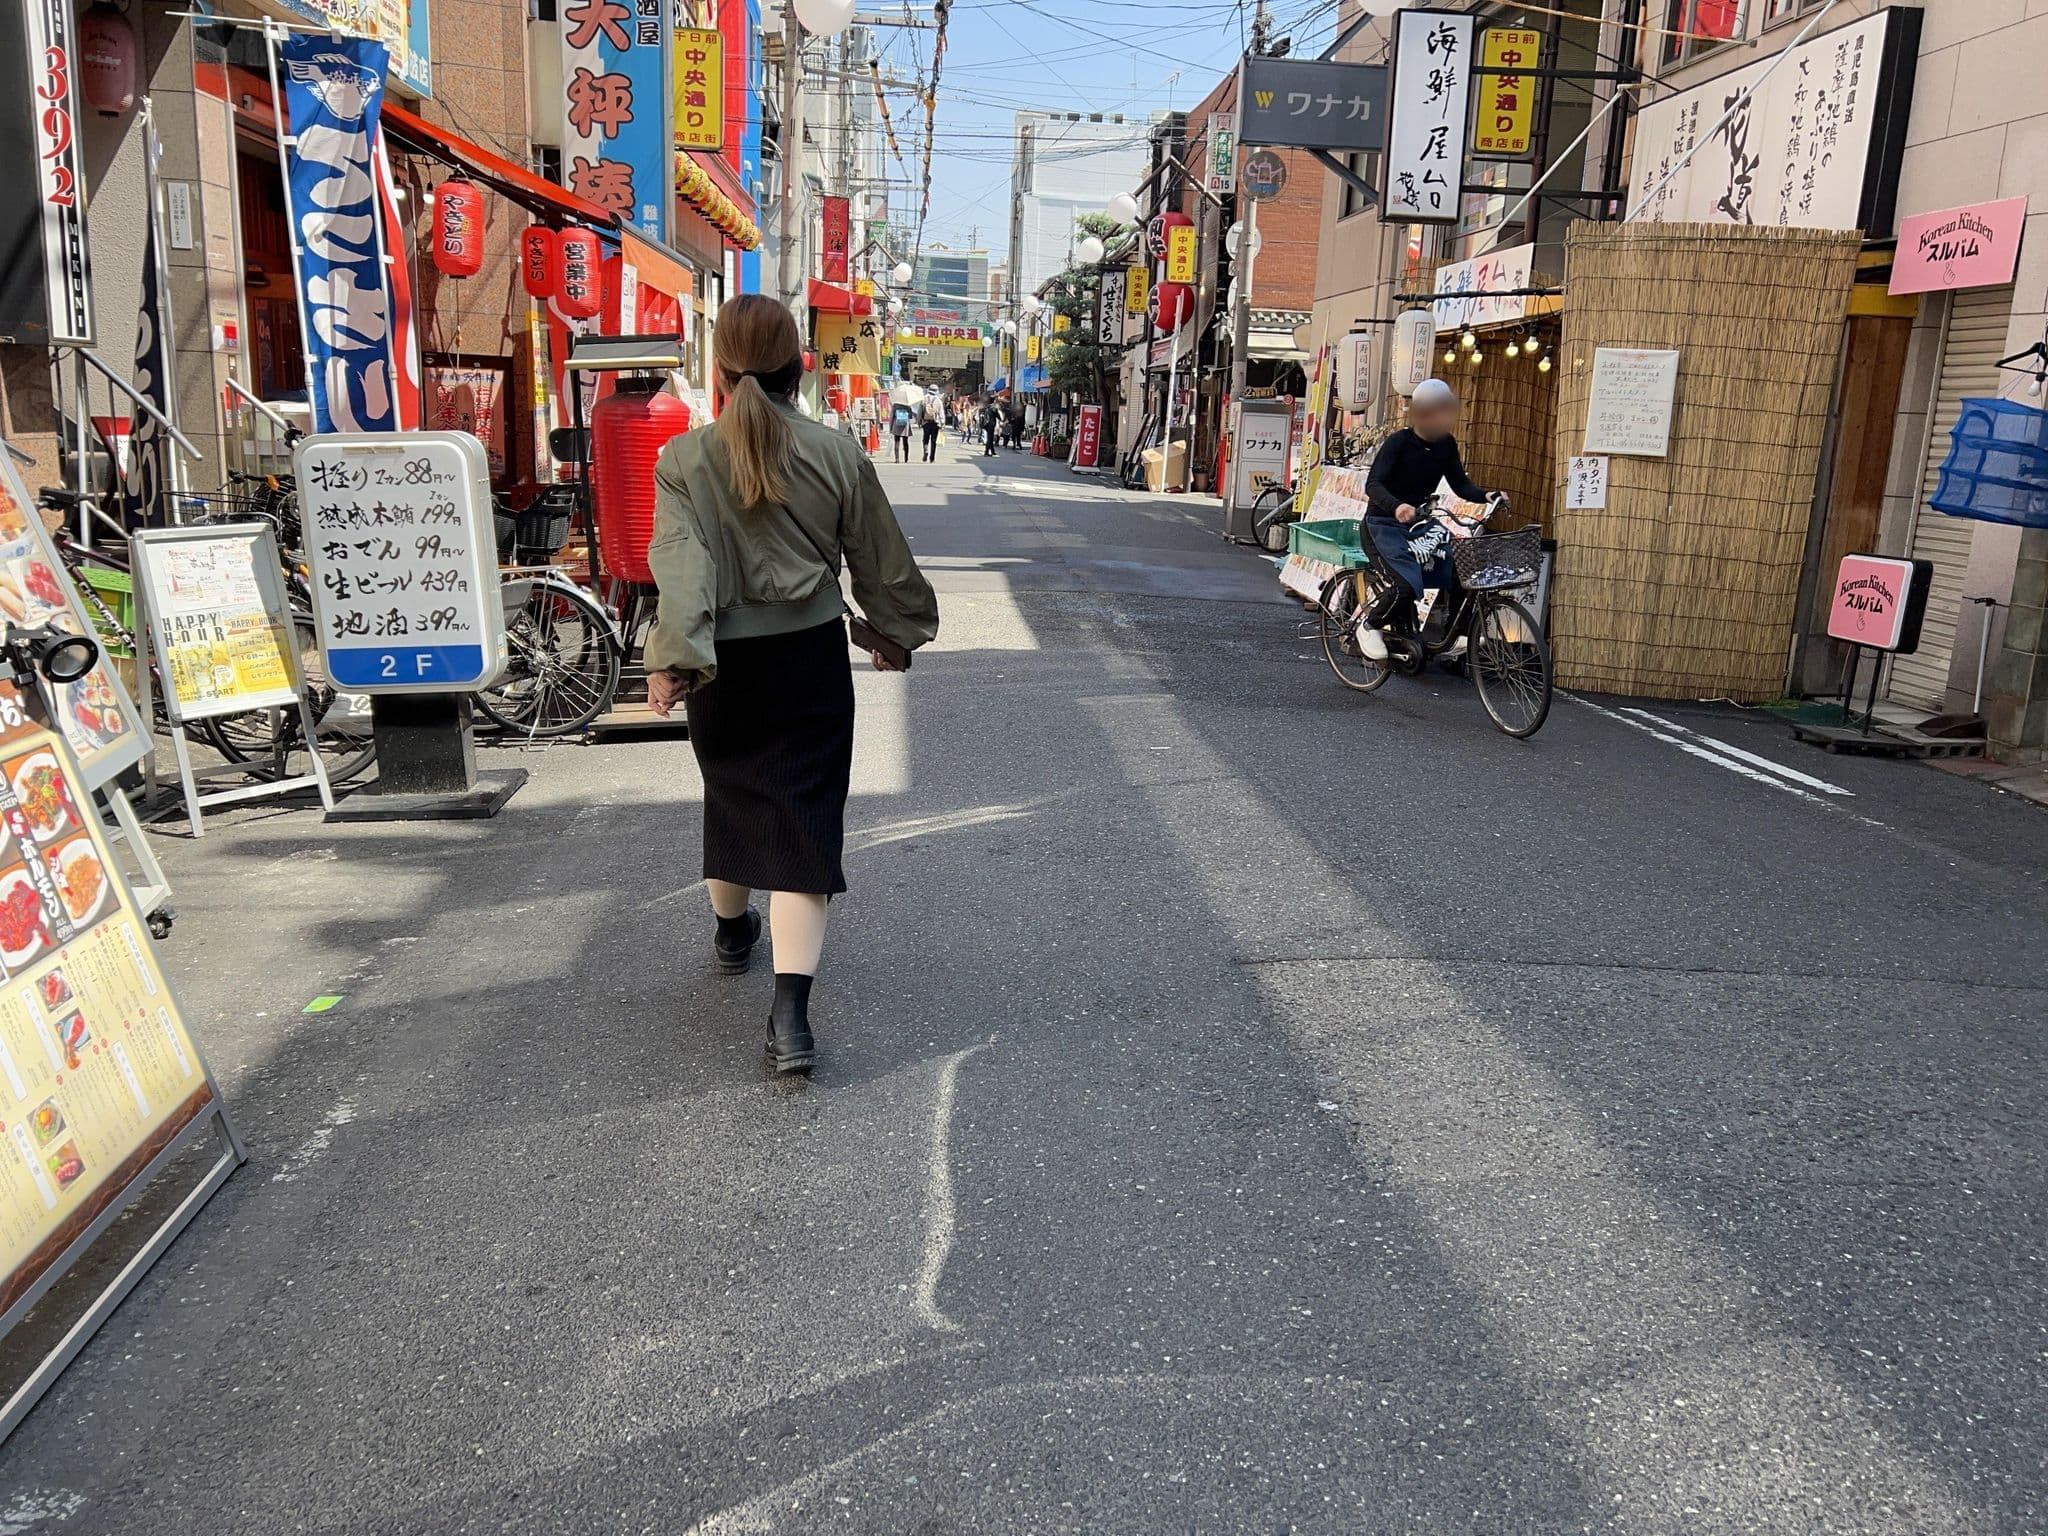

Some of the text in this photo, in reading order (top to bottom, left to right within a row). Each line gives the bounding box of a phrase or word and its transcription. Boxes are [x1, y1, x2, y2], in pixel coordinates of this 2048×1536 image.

[675, 32, 719, 44] 千日前
[1491, 32, 1535, 44] 千日前
[684, 49, 706, 128] 中央通り
[1495, 50, 1520, 133] 中央通り
[1287, 92, 1371, 121] ワナカ
[1421, 22, 1457, 209] 海鮮屋台
[1480, 137, 1524, 149] 商店街
[1221, 180, 1230, 189] 15
[1918, 212, 1994, 254] Korean Kitchen
[1176, 236, 1188, 274] 中央通り
[1926, 237, 1979, 263] スルバム
[67, 222, 84, 328] MIKUNI
[564, 242, 587, 301] 営業中
[1133, 274, 1143, 305] 中央通り
[1101, 285, 1117, 342] せきぐち
[1356, 343, 1371, 401] 寿司肉鶏魚
[1083, 417, 1096, 456] たばこ
[1246, 440, 1282, 451] ワナカ
[311, 459, 368, 491] 握り
[1575, 472, 1588, 506] 吸えます
[1590, 469, 1602, 495] タバコ
[316, 500, 462, 530] 熟成本鮪 199円
[322, 536, 402, 560] おでん
[323, 568, 468, 601] 生ビール 439円
[1839, 574, 1894, 607] Korean Kitchen
[79, 580, 138, 657] CHEVROLET
[1845, 593, 1884, 614] スルバム
[161, 612, 217, 631] HAPPY
[231, 619, 255, 629] HAPPY
[332, 607, 409, 640] 地酒
[206, 687, 235, 698] START
[20, 836, 60, 918] ホルモン
